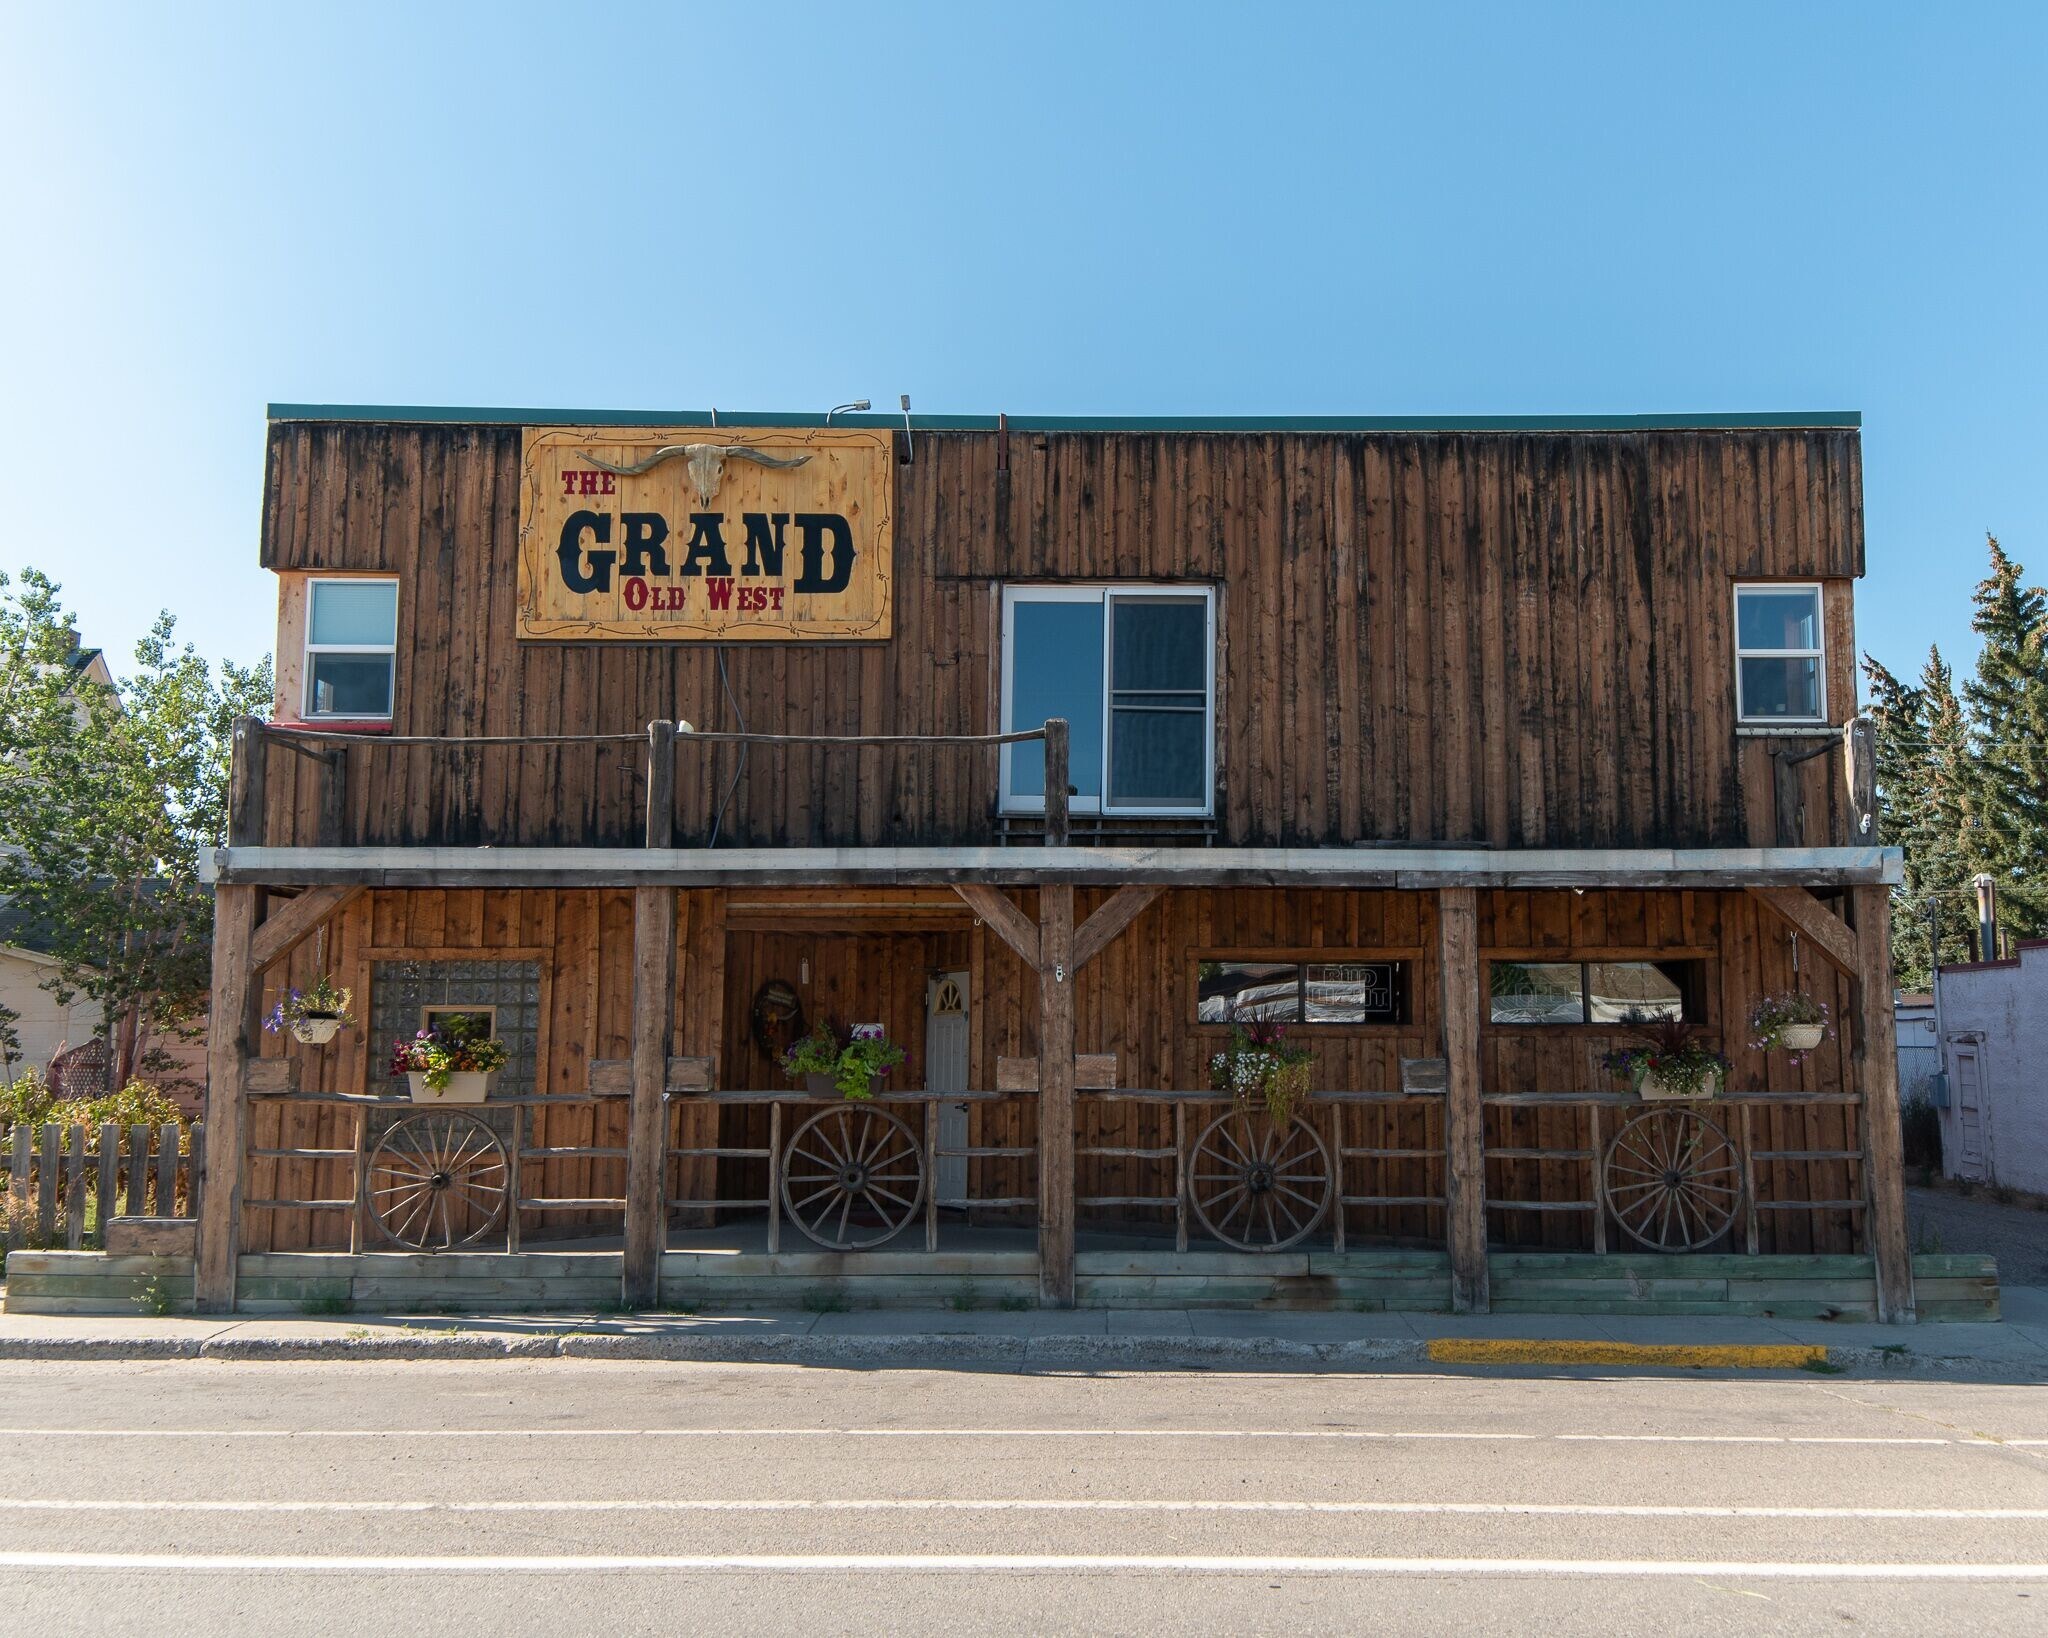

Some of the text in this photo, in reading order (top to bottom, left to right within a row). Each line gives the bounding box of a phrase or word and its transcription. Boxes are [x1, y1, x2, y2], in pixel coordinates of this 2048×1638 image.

[561, 470, 616, 495] THE
[555, 510, 857, 594] GRAND
[1323, 968, 1378, 988] BUD
